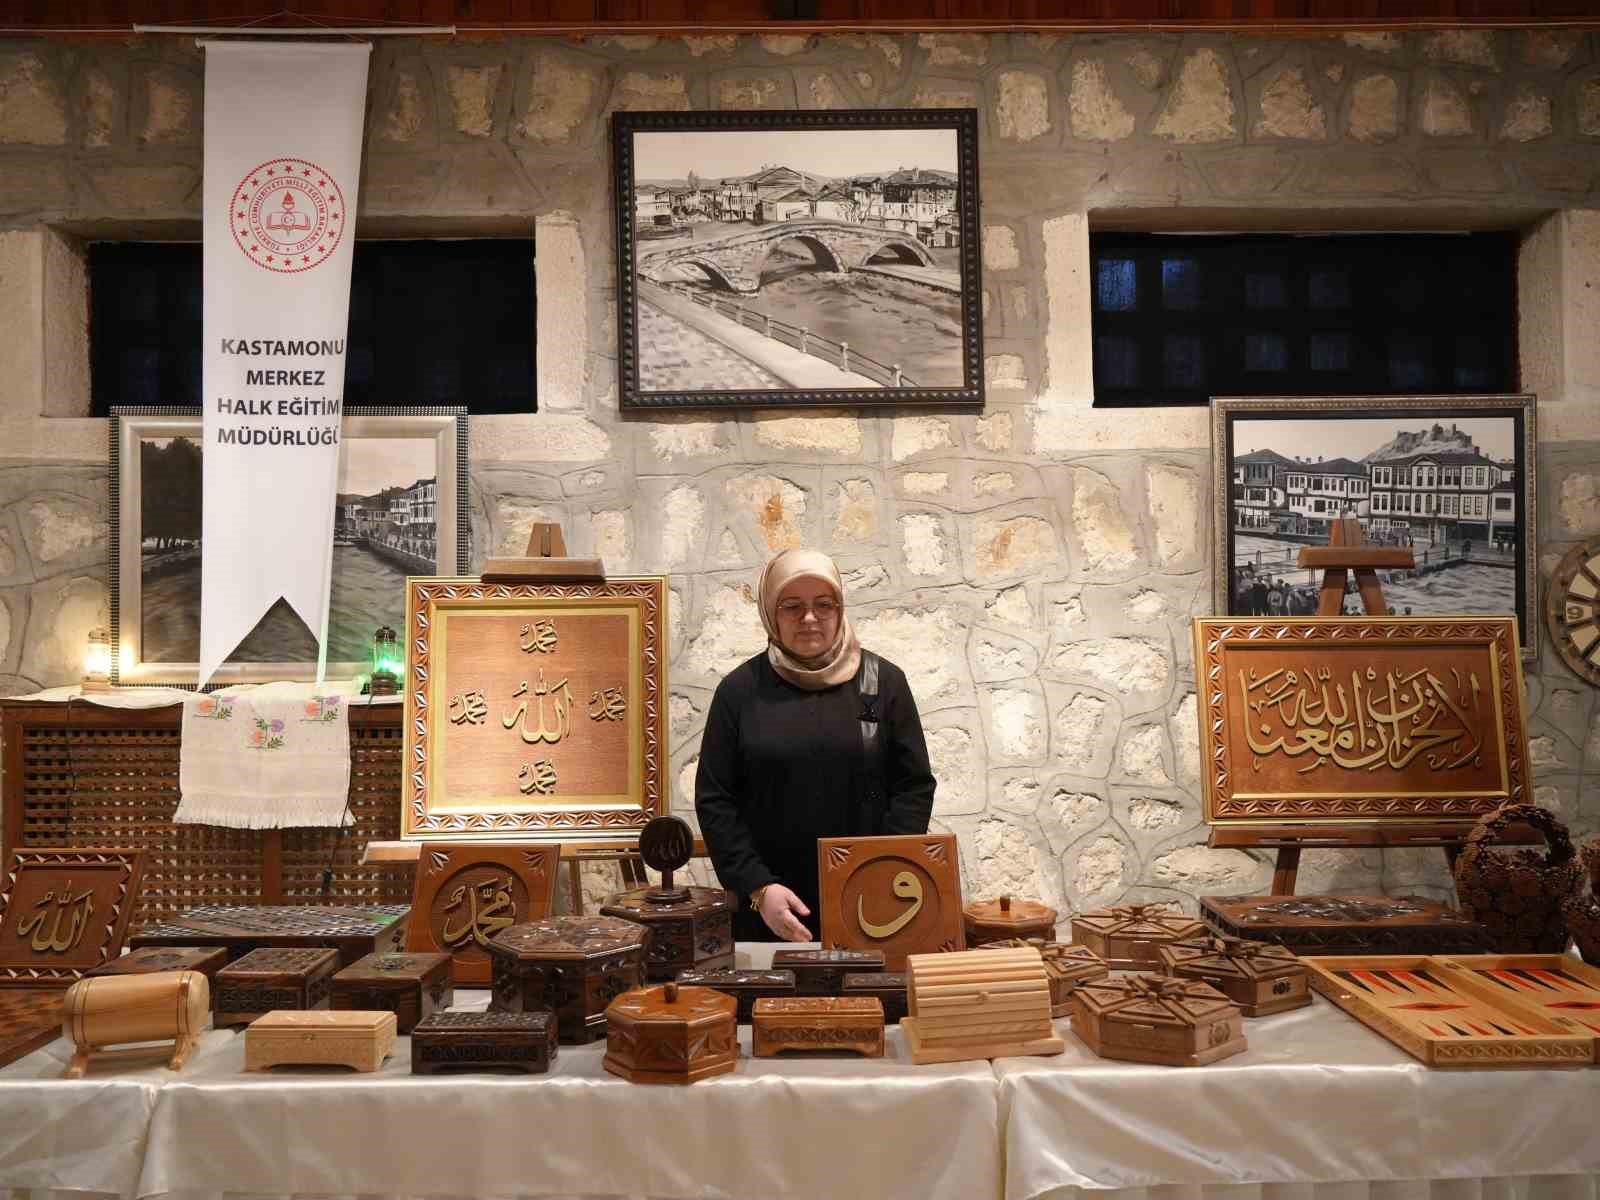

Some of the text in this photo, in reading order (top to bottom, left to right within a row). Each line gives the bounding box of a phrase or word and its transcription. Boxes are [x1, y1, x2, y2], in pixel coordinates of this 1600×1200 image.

[221, 338, 344, 356] KASTAMONU
[246, 370, 325, 386] MERKEZ
[217, 396, 340, 416] HALK EĞİTİM
[502, 667, 574, 744] الله
[17, 880, 95, 951] الله
[858, 871, 923, 938] و
